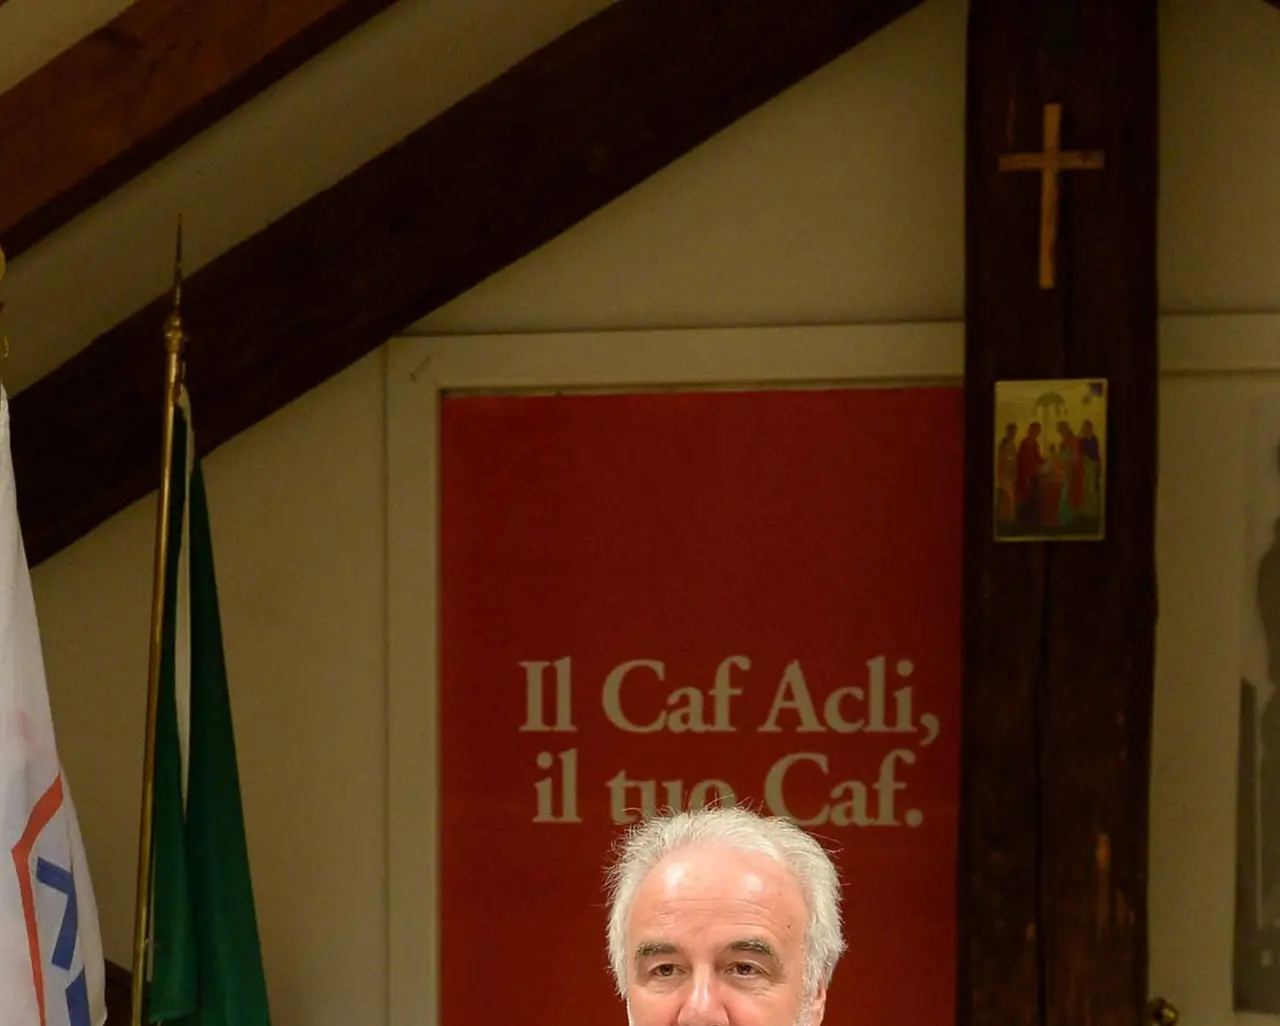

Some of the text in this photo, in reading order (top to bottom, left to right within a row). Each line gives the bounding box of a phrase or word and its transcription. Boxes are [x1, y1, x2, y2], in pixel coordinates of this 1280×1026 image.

[519, 655, 941, 746] Il Caf Acli,
[532, 748, 582, 823] il
[764, 748, 924, 828] Caf.
